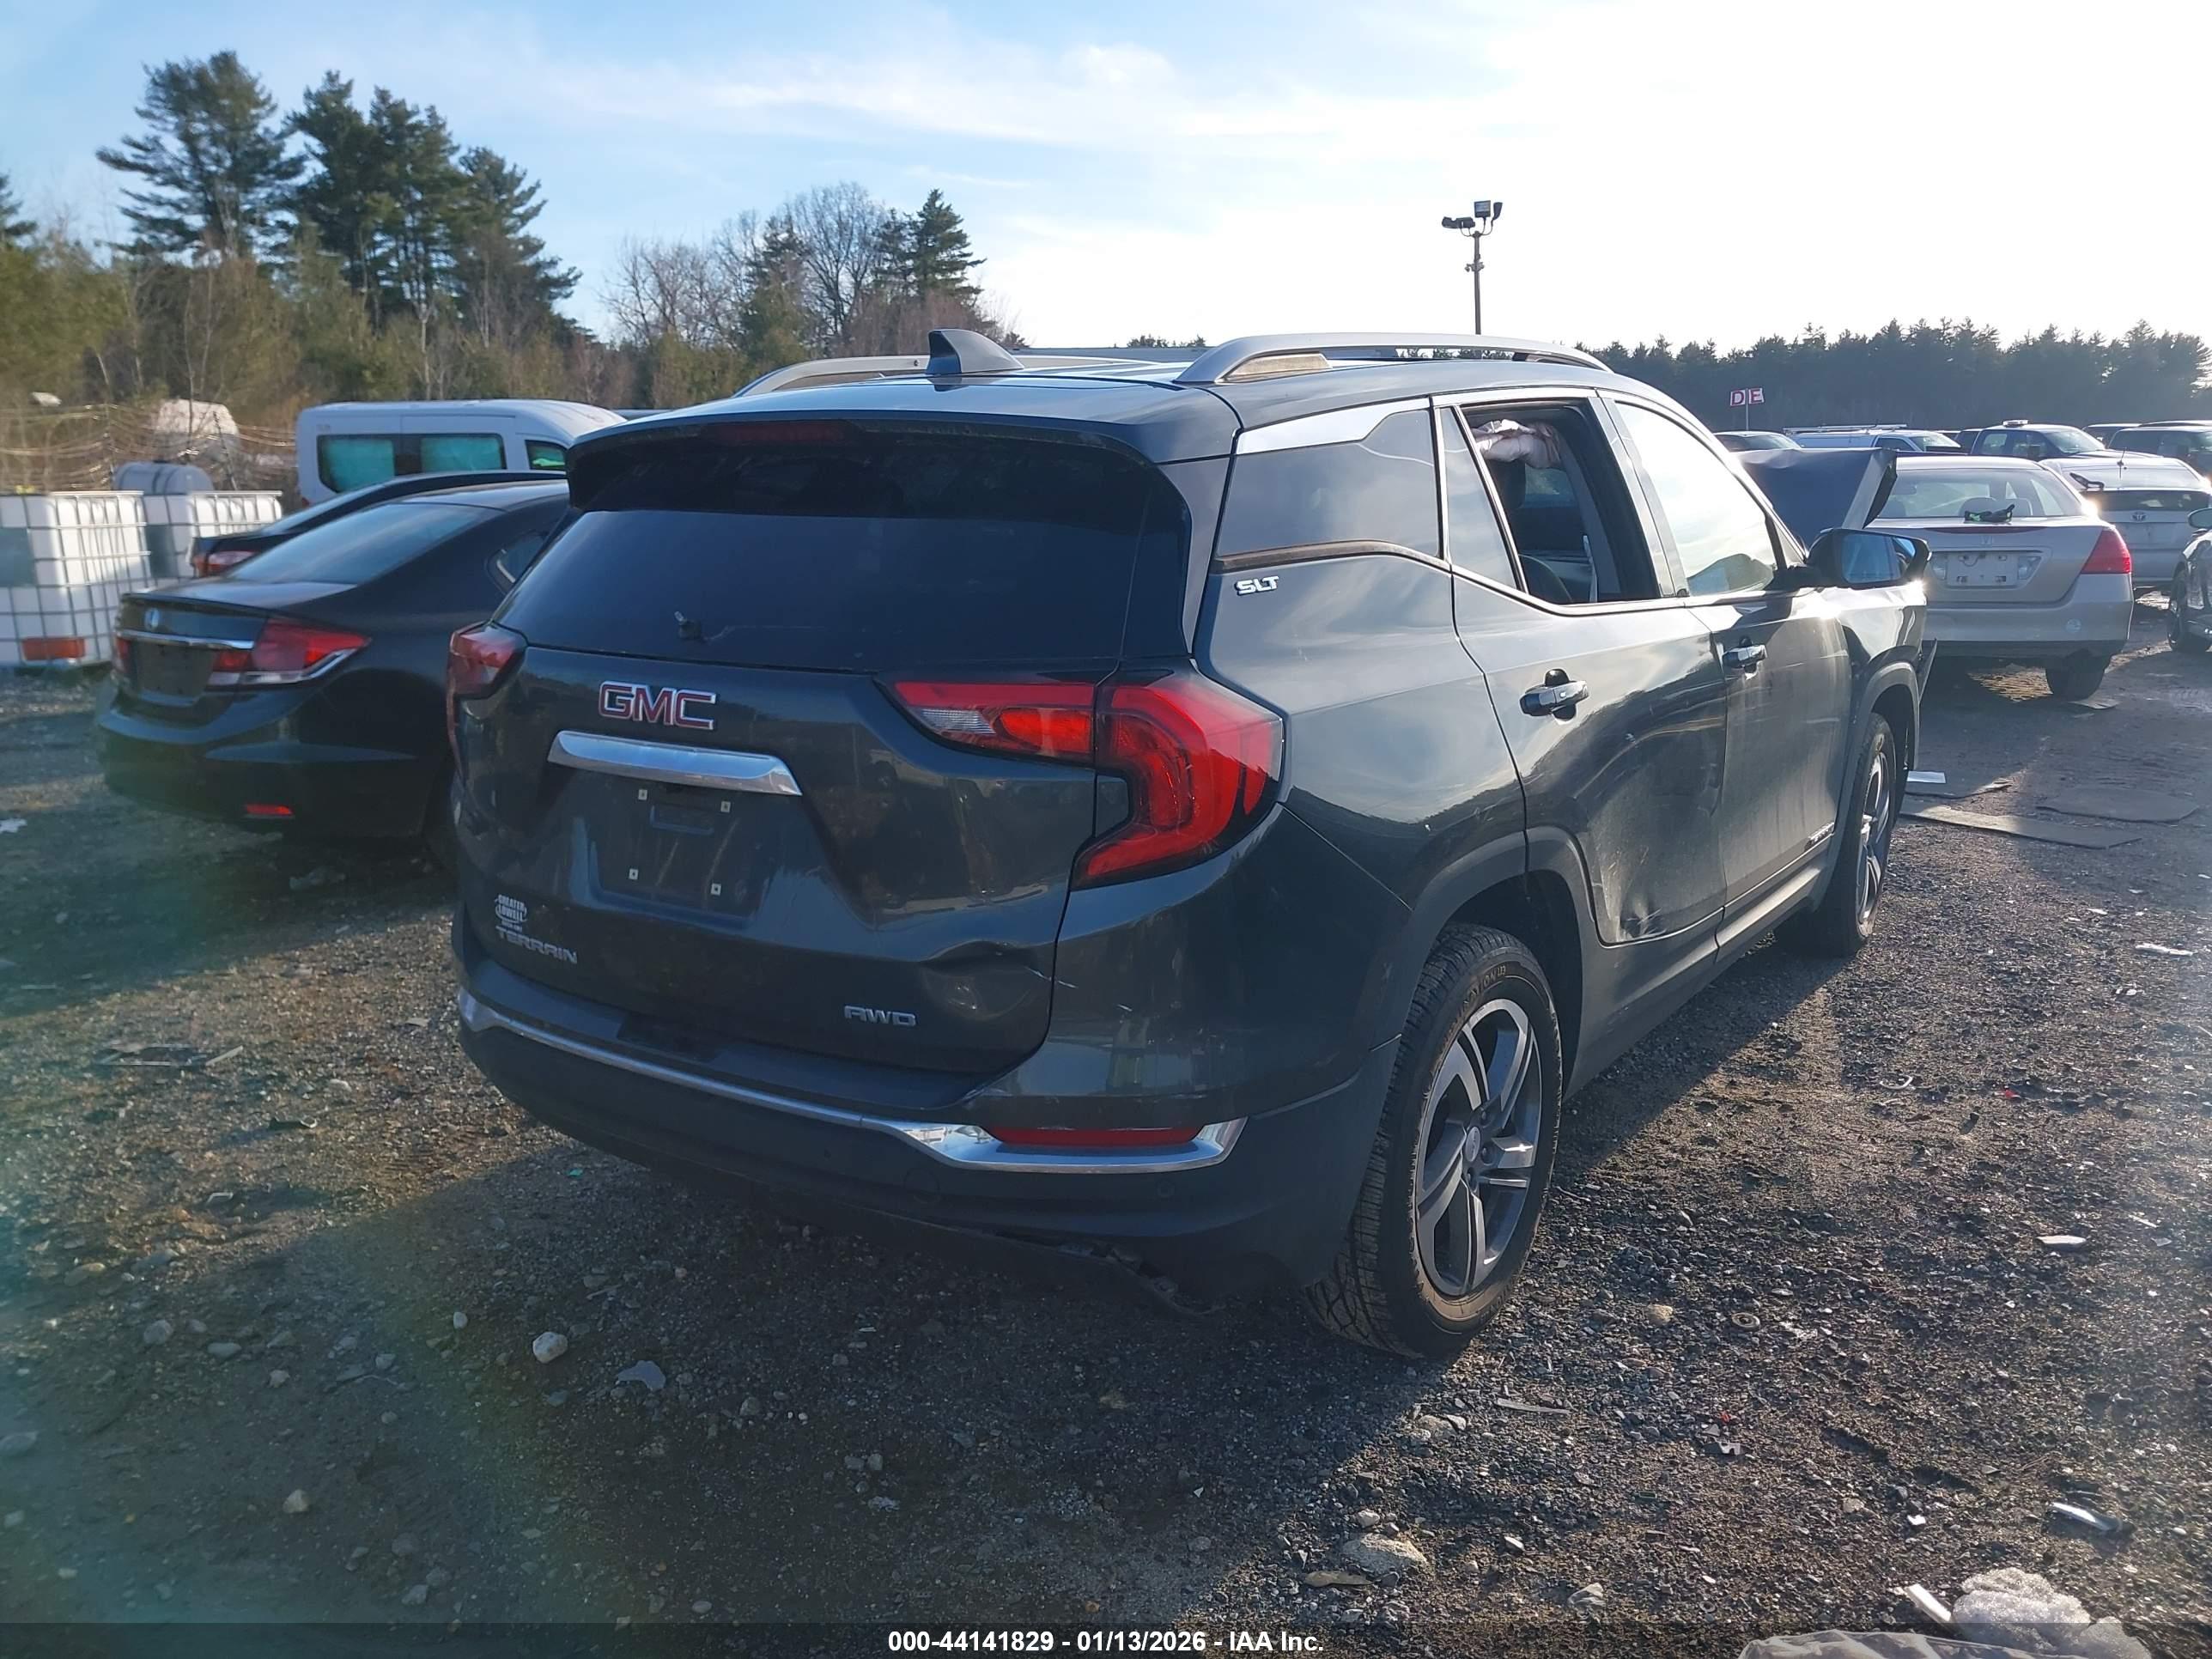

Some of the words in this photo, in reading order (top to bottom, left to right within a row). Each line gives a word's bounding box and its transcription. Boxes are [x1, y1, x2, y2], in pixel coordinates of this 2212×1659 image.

[1234, 575, 1279, 596] SLT
[599, 680, 717, 731] GMC
[495, 926, 578, 964] TERRAIN
[844, 1005, 916, 1026] AWD
